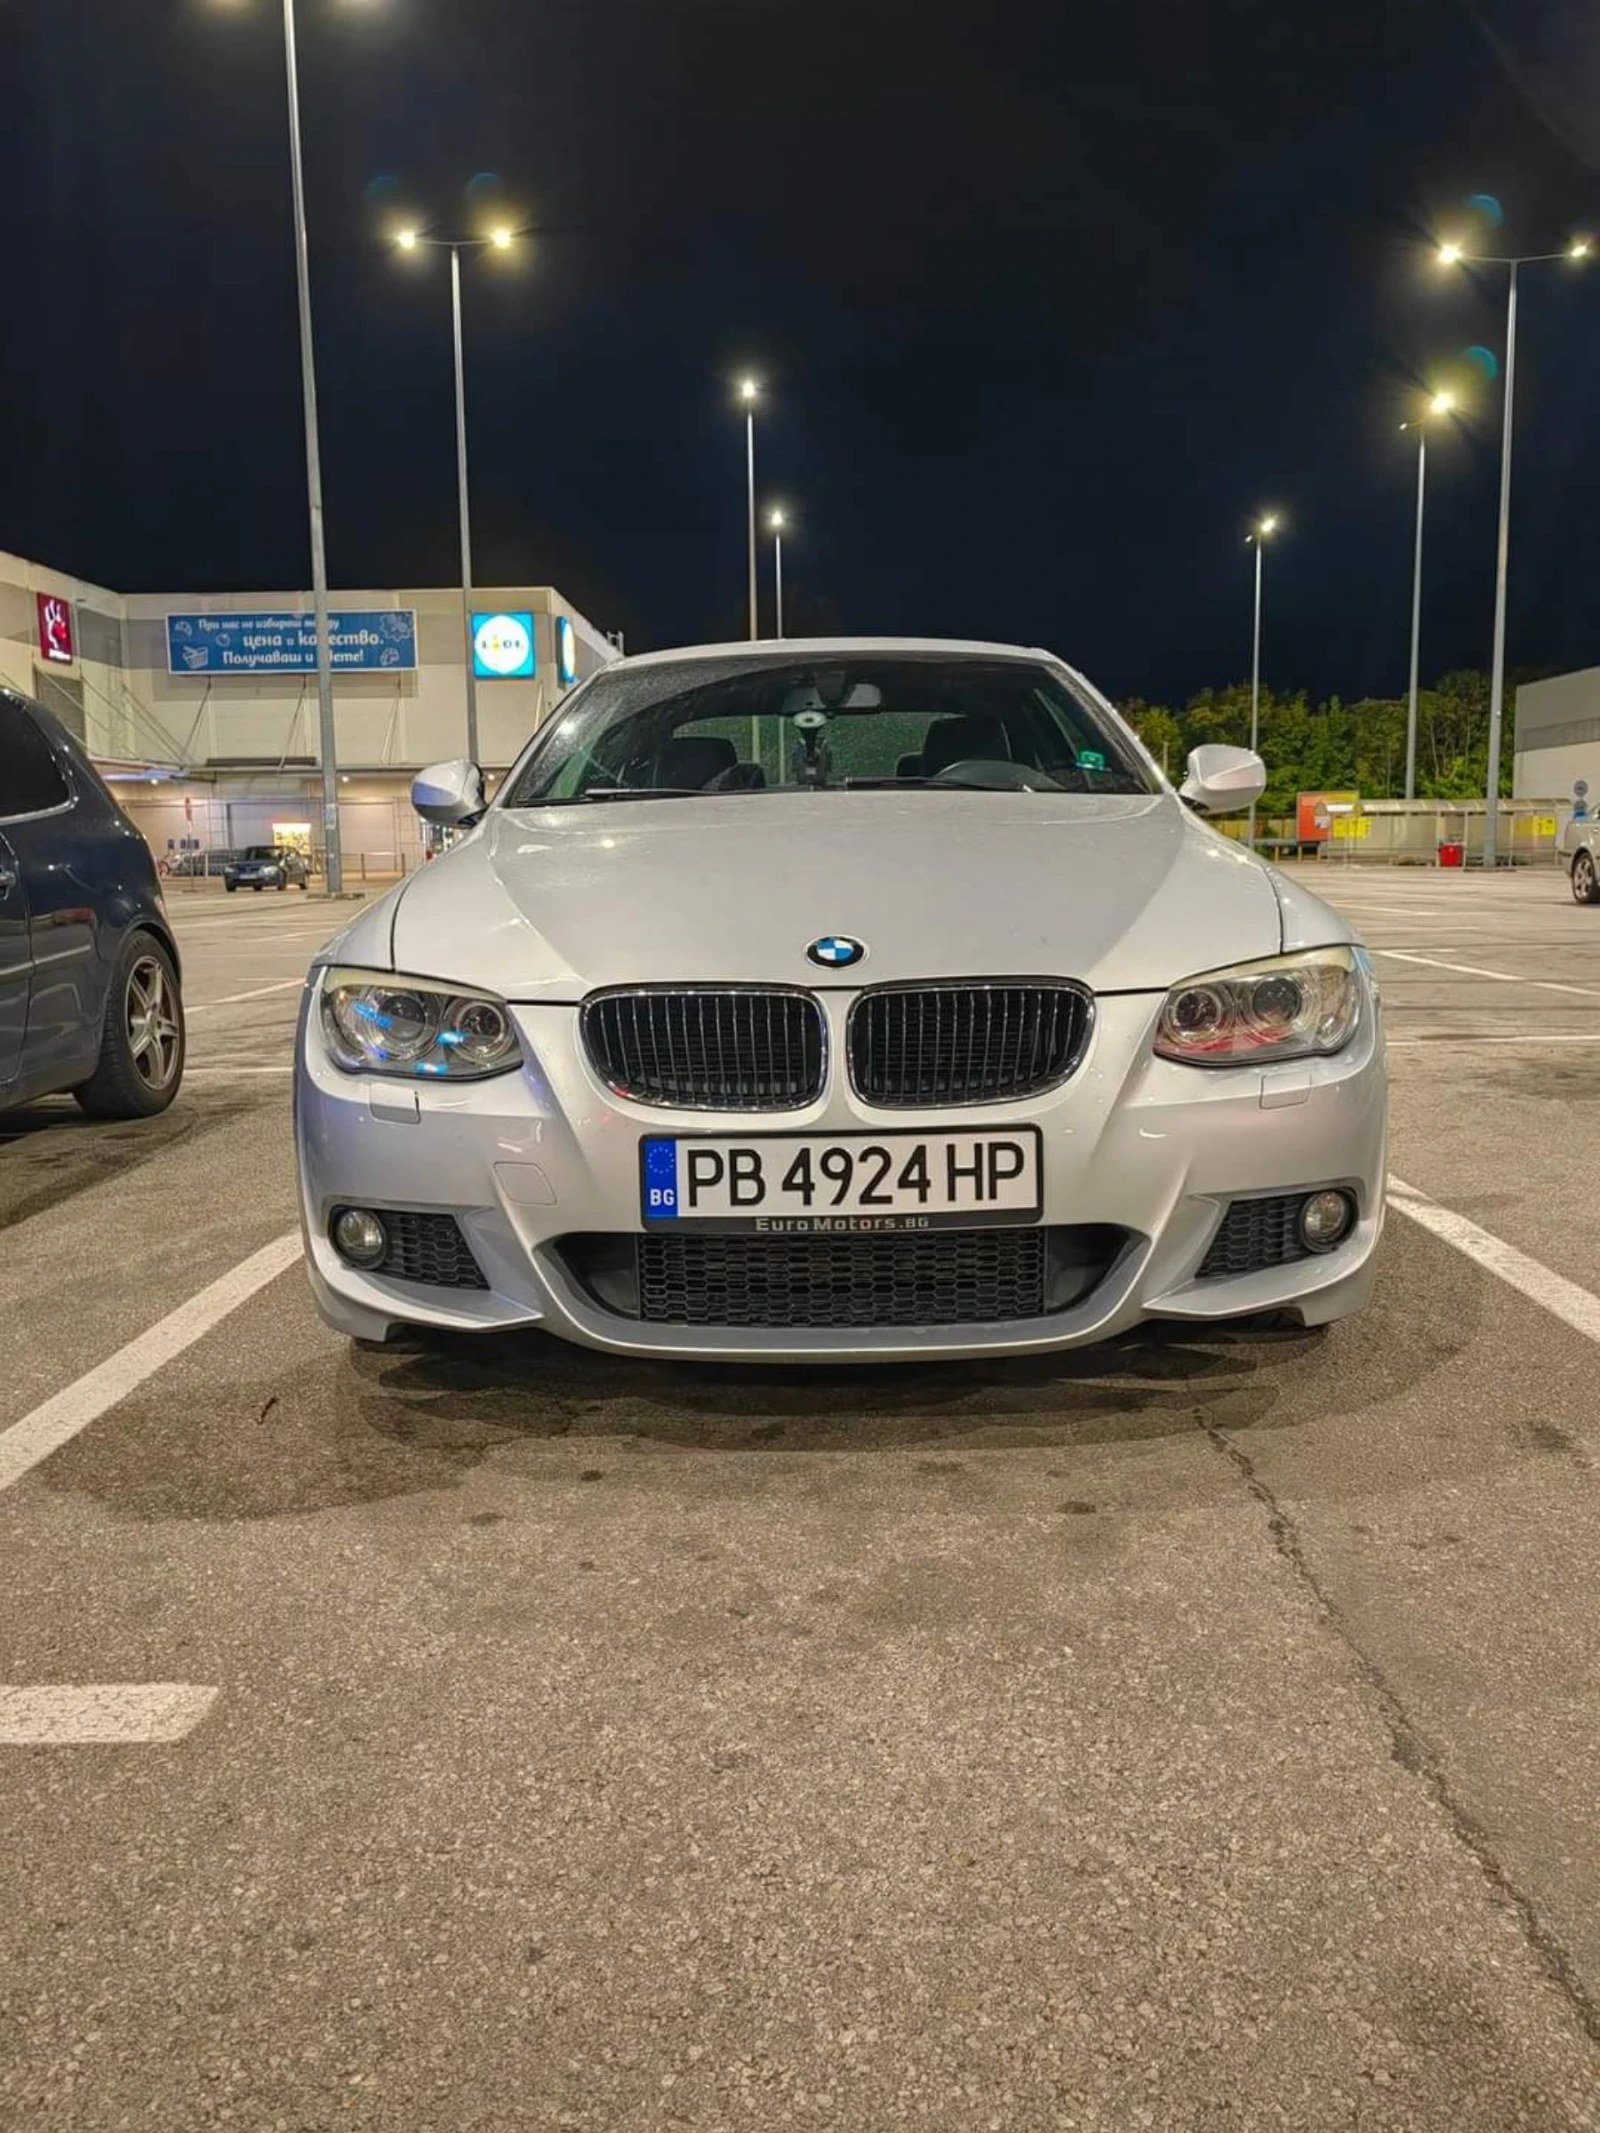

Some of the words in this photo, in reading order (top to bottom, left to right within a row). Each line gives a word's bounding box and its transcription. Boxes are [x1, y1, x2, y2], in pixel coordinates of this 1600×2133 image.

[243, 634, 283, 652] цена
[298, 629, 384, 647] каество.
[223, 649, 302, 668] Получаваш
[305, 652, 314, 663] и
[687, 1148, 766, 1208] PB
[782, 1143, 932, 1207] 4924
[946, 1141, 1025, 1203] HP
[650, 1189, 675, 1207] BG
